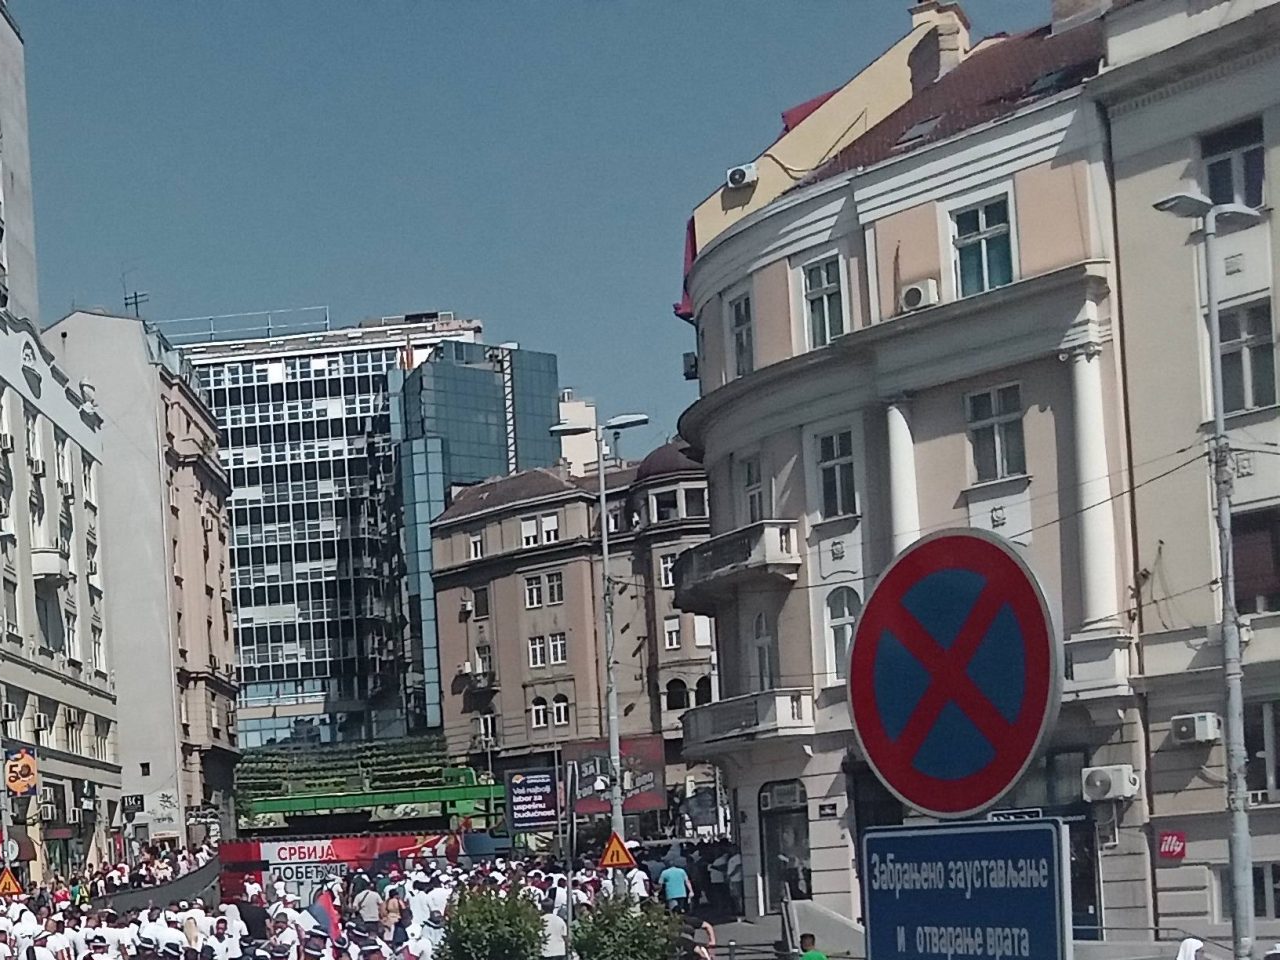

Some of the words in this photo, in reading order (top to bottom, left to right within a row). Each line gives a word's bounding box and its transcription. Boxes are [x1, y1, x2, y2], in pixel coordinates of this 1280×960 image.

[277, 845, 336, 861] СРБИЈА
[1161, 835, 1184, 855] illy
[871, 853, 945, 900] Забрањено
[948, 857, 1049, 900] заустављање
[896, 925, 907, 952] и
